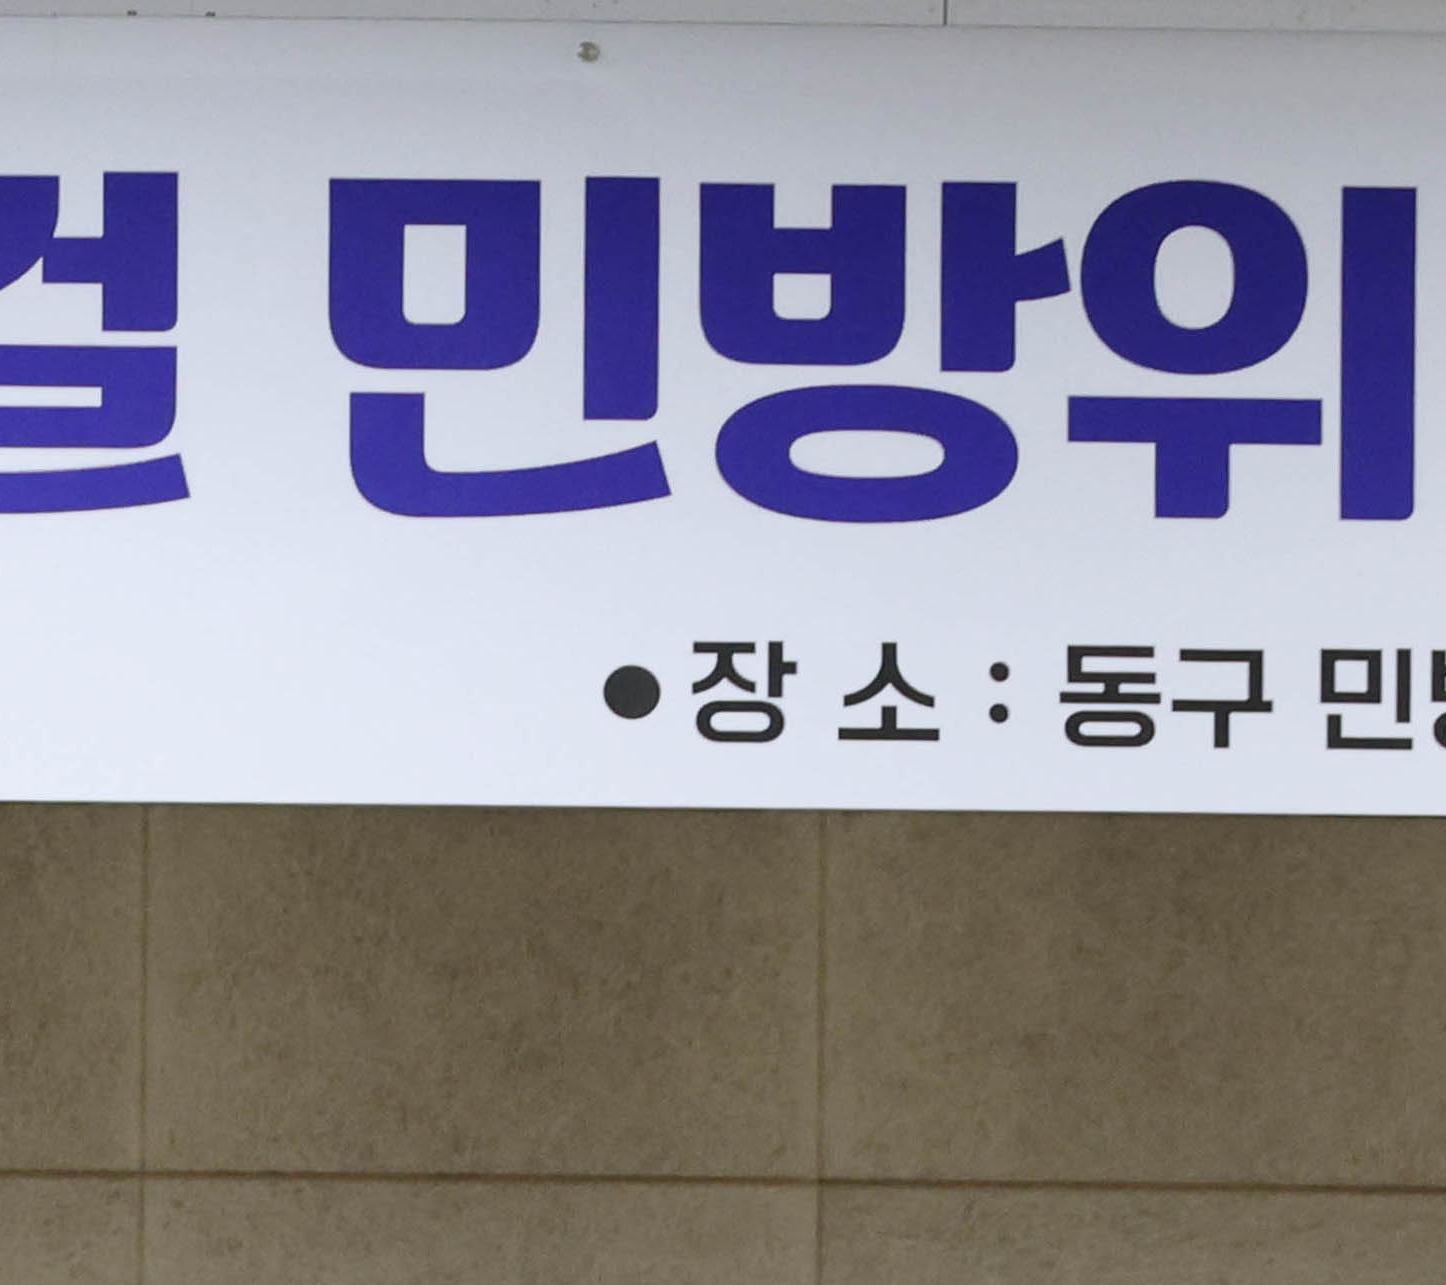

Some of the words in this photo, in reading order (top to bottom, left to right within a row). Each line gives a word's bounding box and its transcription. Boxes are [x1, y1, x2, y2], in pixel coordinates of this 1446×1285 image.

[329, 176, 1417, 523] 민방위
[691, 641, 798, 743] 장
[837, 642, 940, 742] 소
[1059, 645, 1273, 749] 동구
